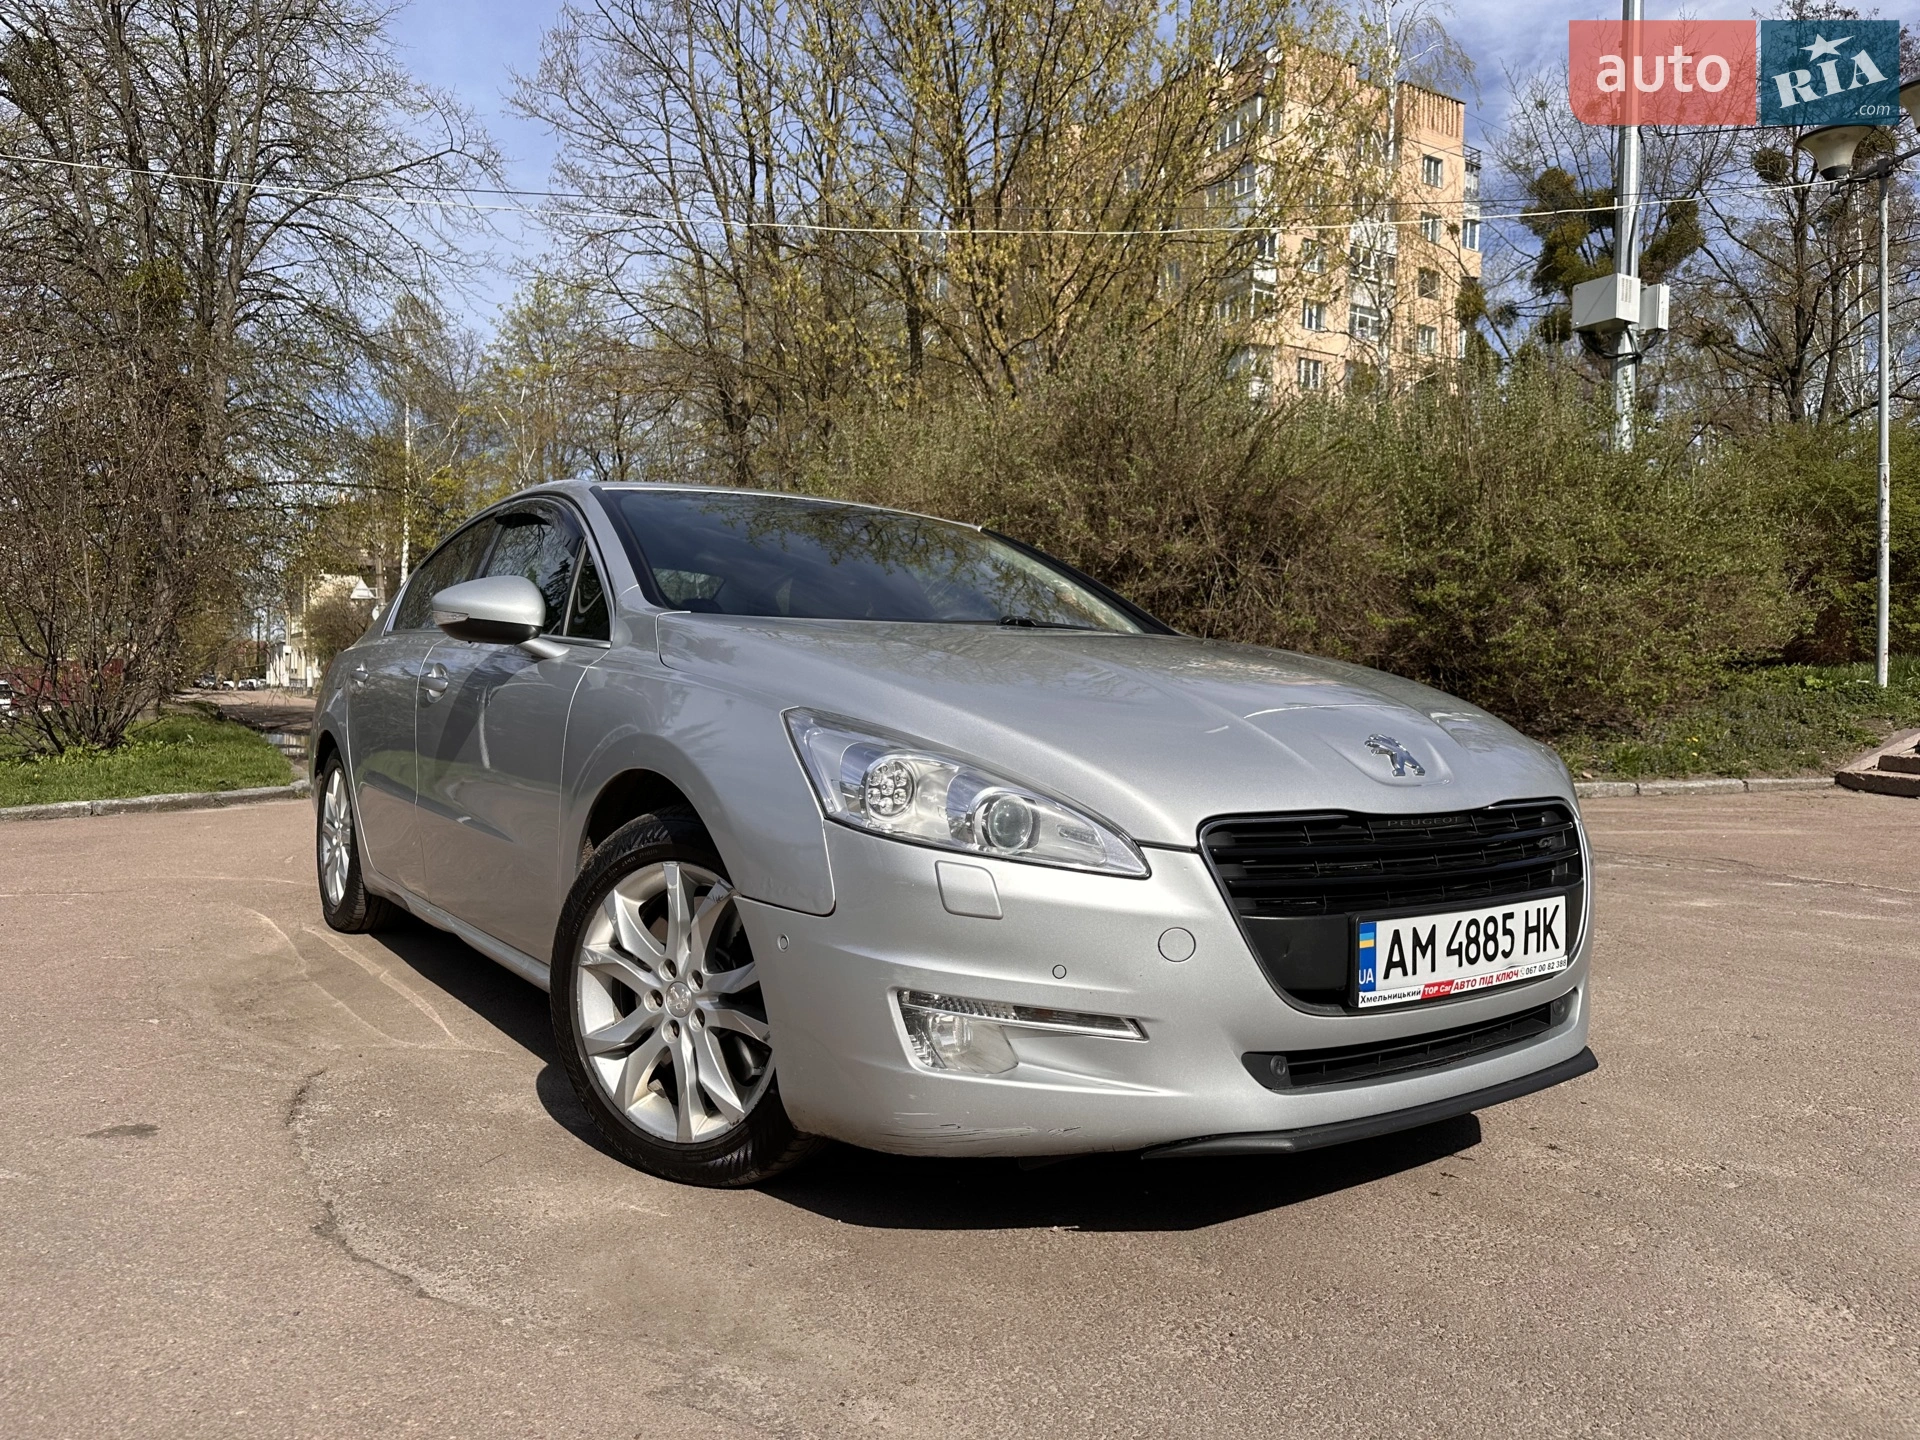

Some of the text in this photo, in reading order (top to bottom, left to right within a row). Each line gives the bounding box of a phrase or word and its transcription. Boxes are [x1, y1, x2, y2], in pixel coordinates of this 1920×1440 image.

[1387, 816, 1461, 827] PEUGEOT
[1383, 904, 1560, 980] AM 4885 HK
[1359, 968, 1375, 985] UA
[1525, 966, 1537, 975] 067
[1451, 969, 1520, 991] АВТО ПІД КЛЮЧ
[1360, 988, 1421, 1004] Хмельницький
[1424, 984, 1451, 995] TOP Car
